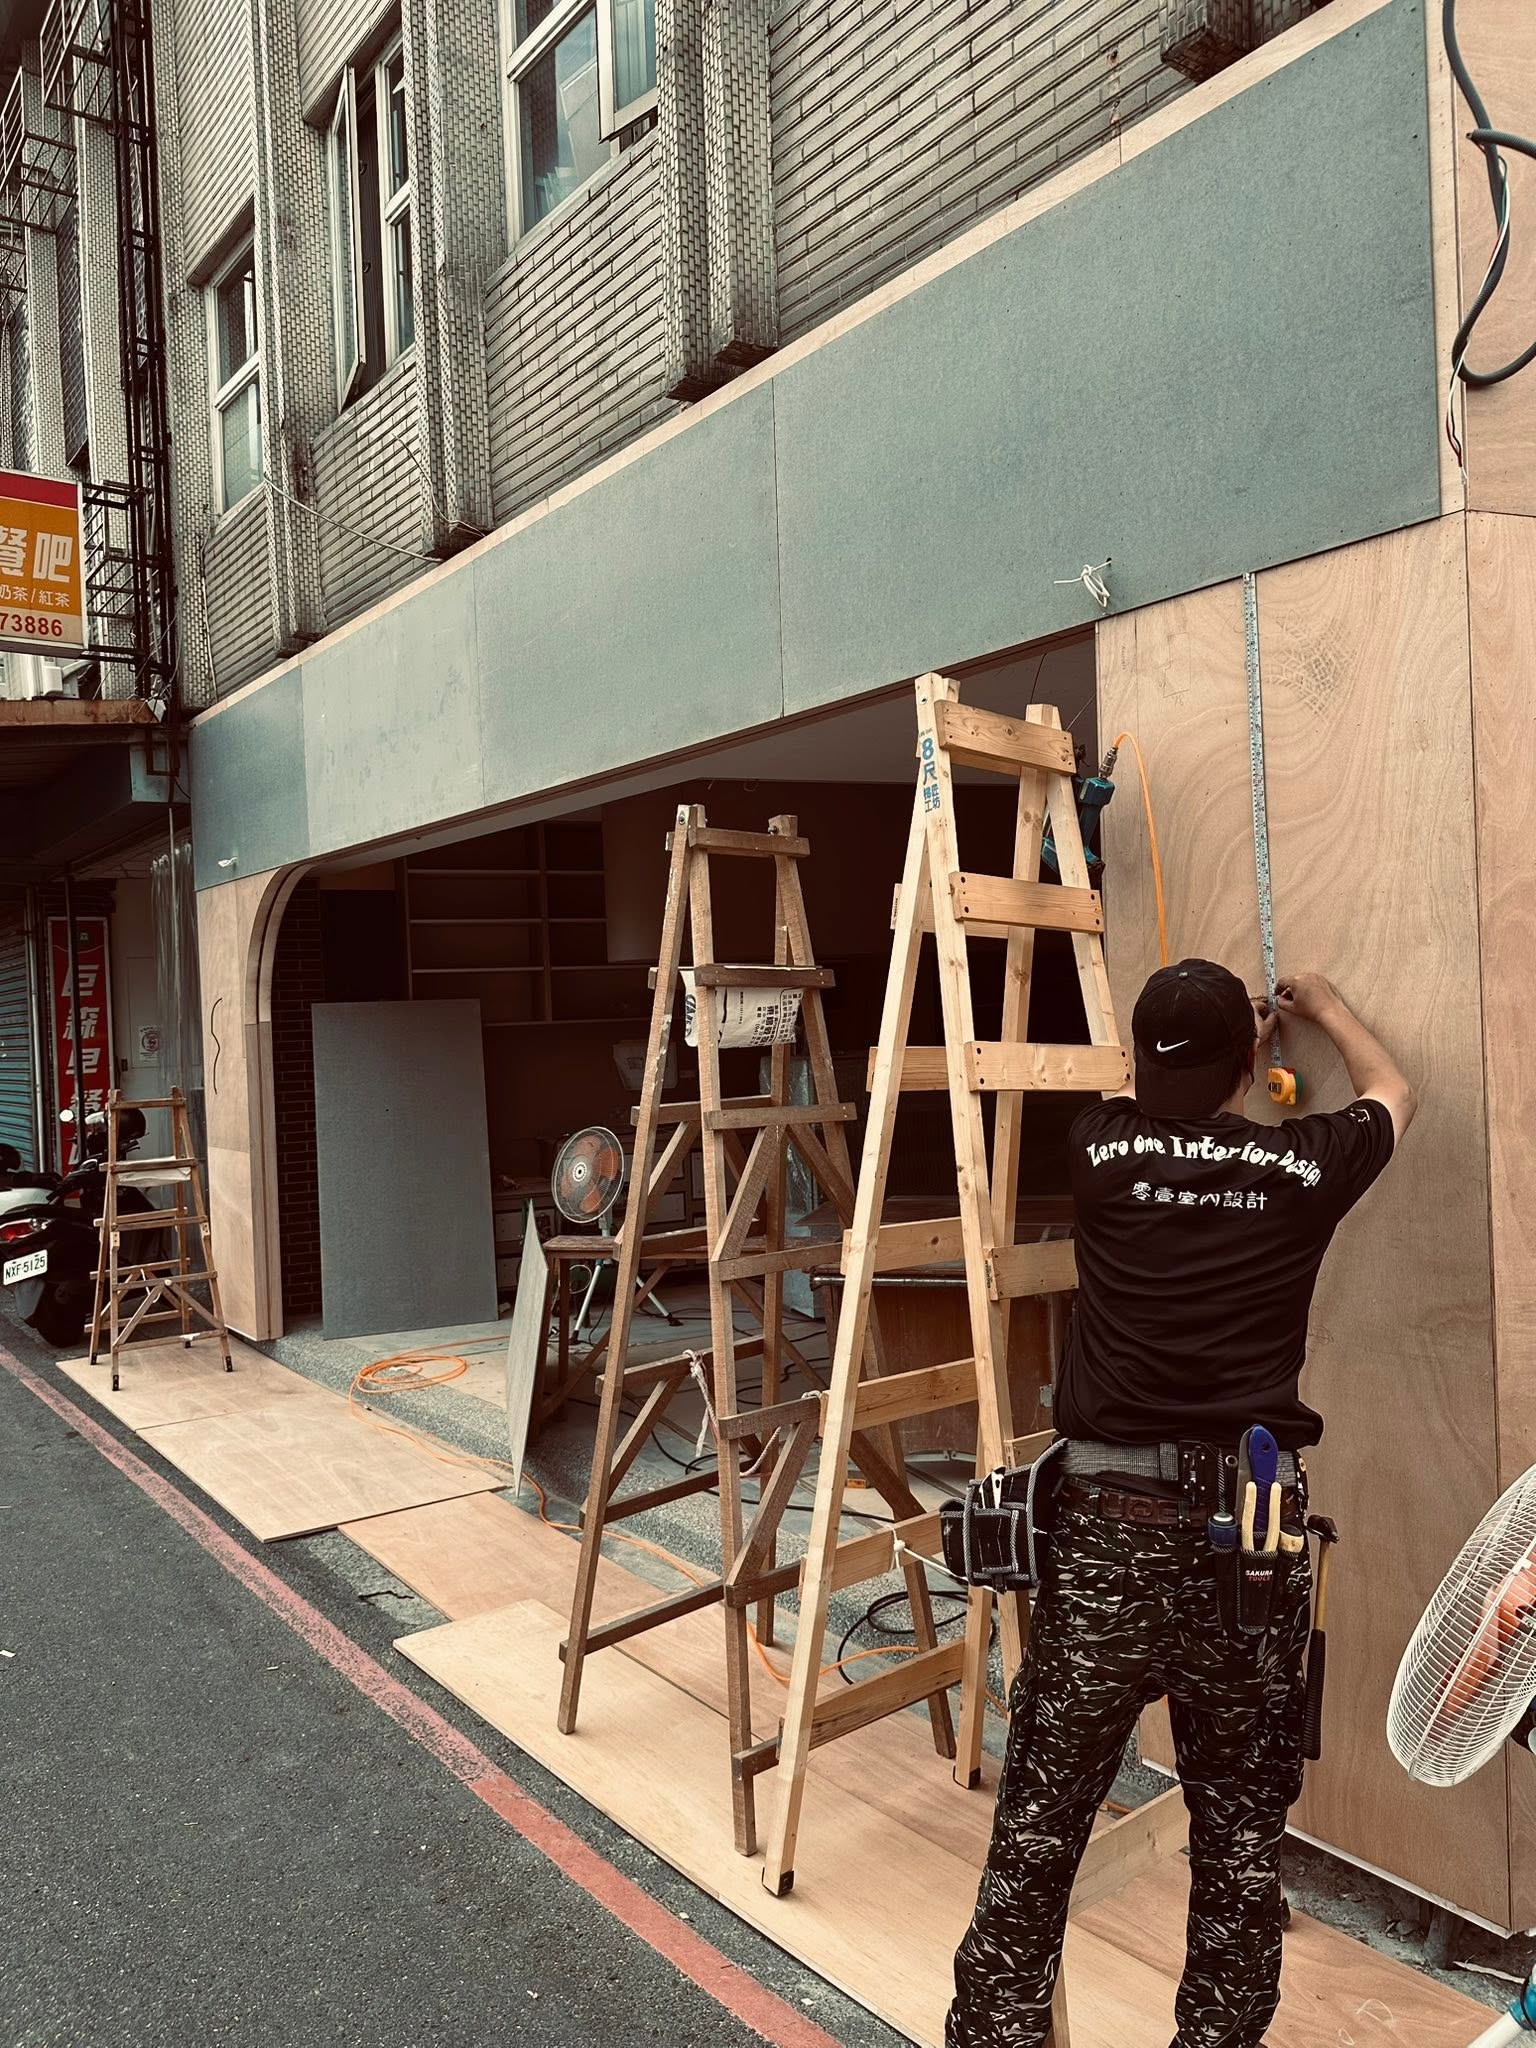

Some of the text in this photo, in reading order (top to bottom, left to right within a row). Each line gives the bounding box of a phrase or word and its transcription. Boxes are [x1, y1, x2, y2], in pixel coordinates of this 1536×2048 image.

[0, 612, 63, 637] 73886
[1086, 1140, 1129, 1168] Zero
[1133, 1134, 1166, 1155] One
[1168, 1135, 1280, 1167] Interior
[5, 1255, 46, 1280] NXF-5125
